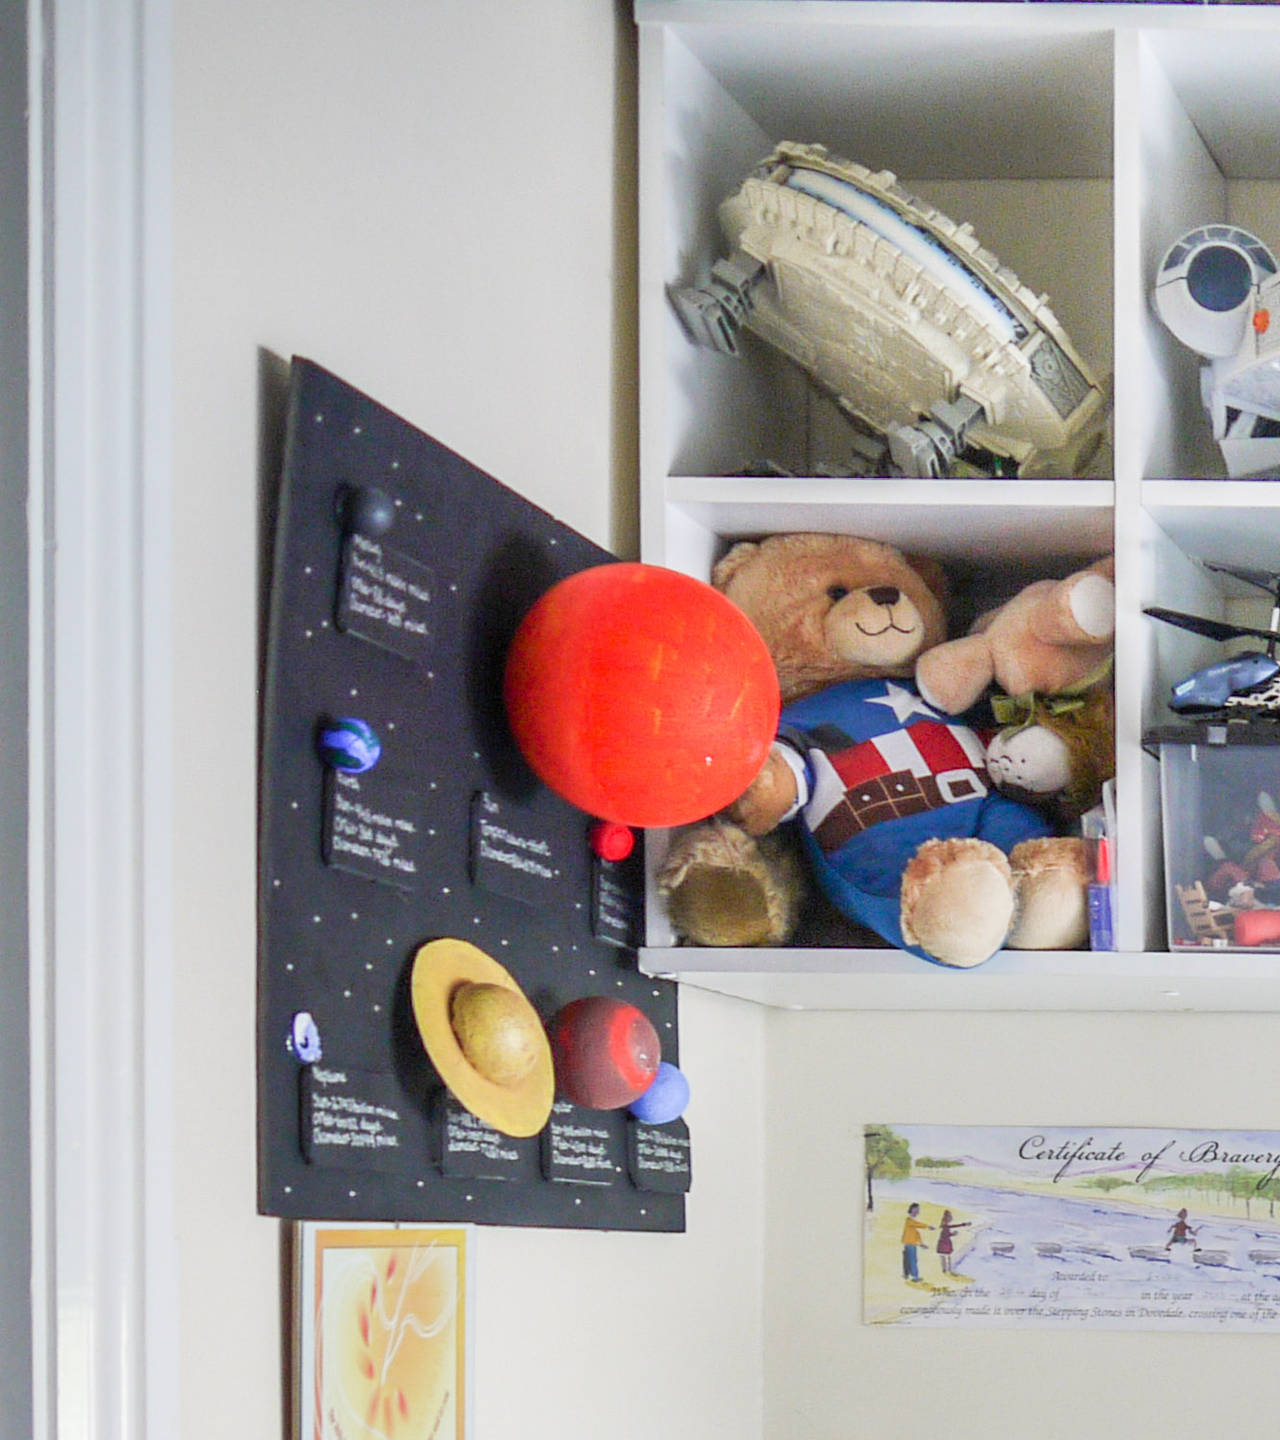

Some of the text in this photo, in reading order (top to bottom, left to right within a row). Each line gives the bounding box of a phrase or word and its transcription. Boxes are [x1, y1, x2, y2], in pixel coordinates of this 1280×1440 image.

[1018, 1135, 1128, 1183] Certificate
[1136, 1140, 1176, 1183] of
[1045, 1306, 1089, 1320] Stepping
[1091, 1306, 1122, 1317] Stones
